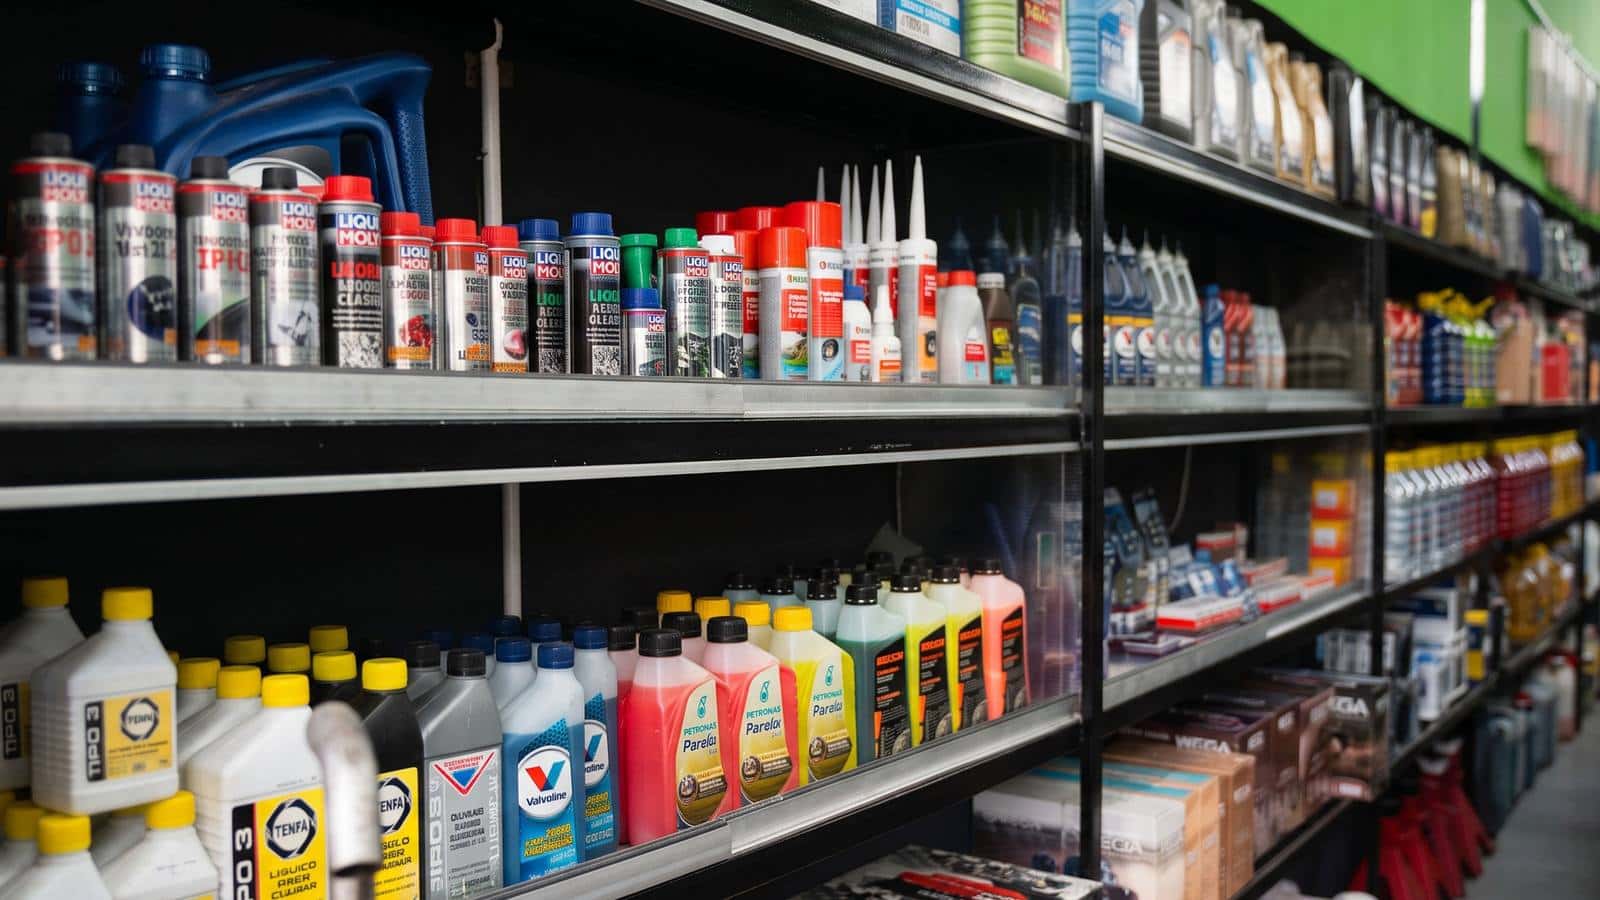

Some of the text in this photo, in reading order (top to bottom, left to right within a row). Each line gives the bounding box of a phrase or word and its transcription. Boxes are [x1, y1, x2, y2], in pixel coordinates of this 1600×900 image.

[745, 705, 782, 720] PETRONAS
[682, 721, 717, 736] PETRONAS
[377, 796, 404, 813] ENFA
[526, 791, 567, 807] Valvoline
[274, 818, 309, 839] TENFA
